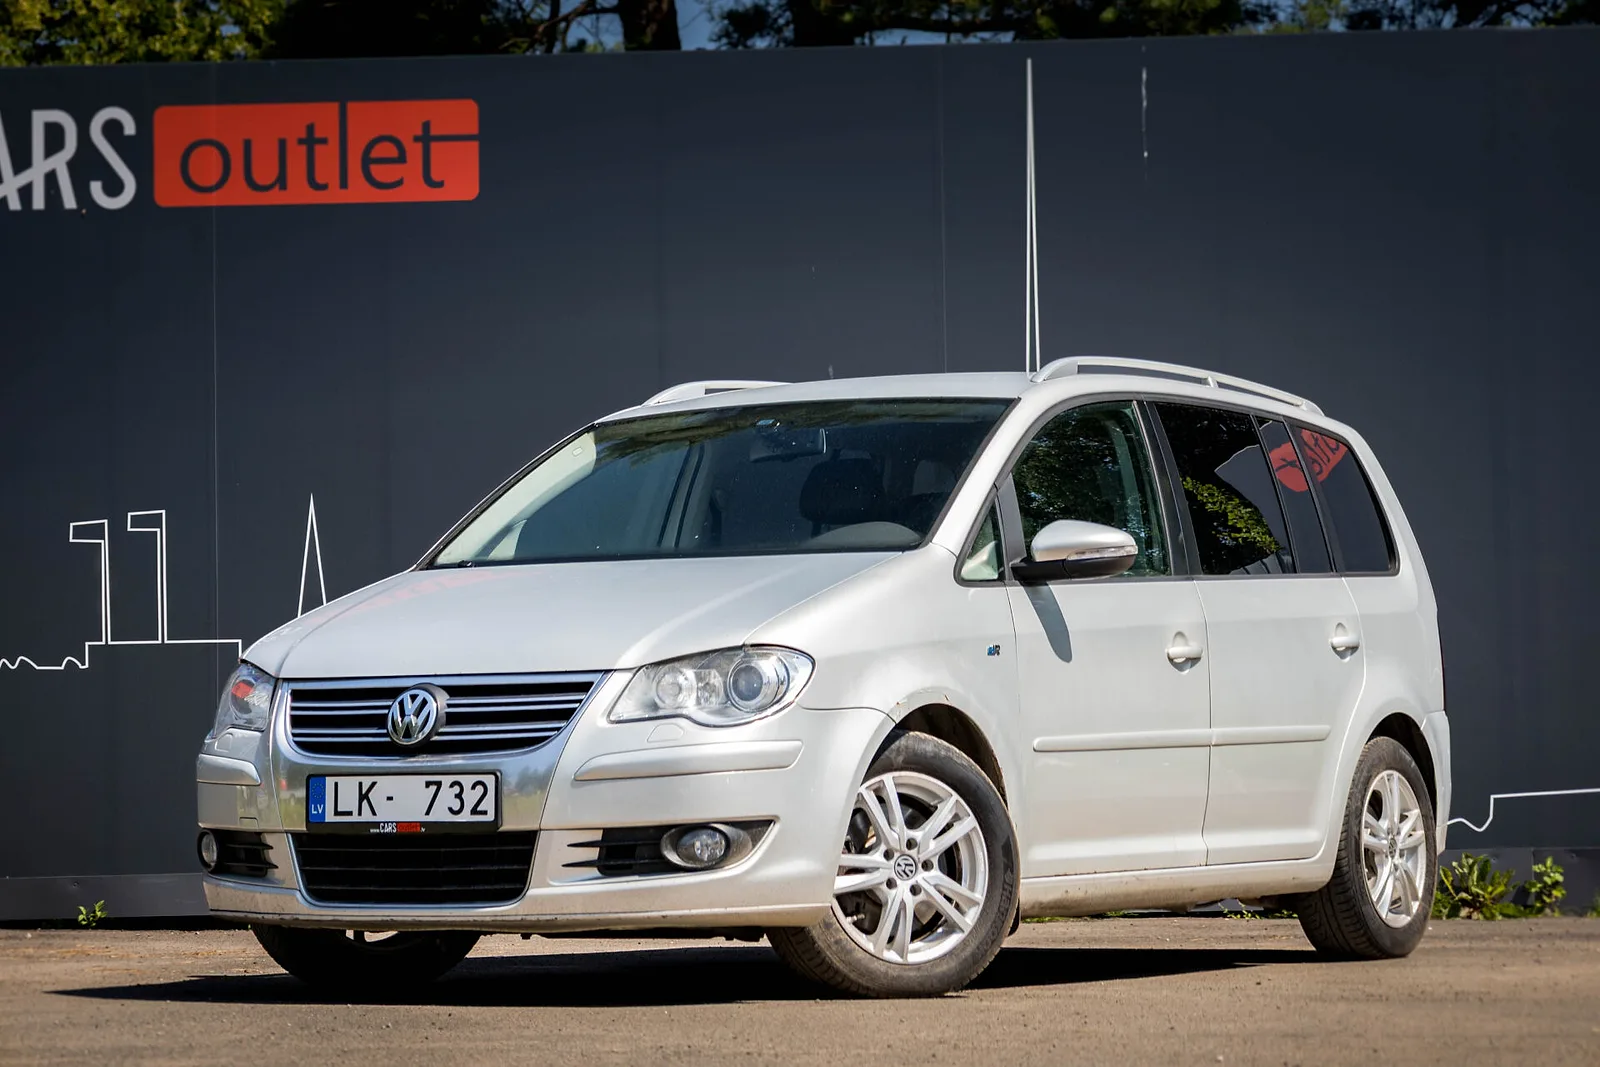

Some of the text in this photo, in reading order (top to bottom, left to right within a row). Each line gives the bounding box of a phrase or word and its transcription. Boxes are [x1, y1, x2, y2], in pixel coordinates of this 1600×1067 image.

[180, 102, 479, 193] outlet
[311, 804, 324, 814] LV
[425, 780, 488, 816] 732
